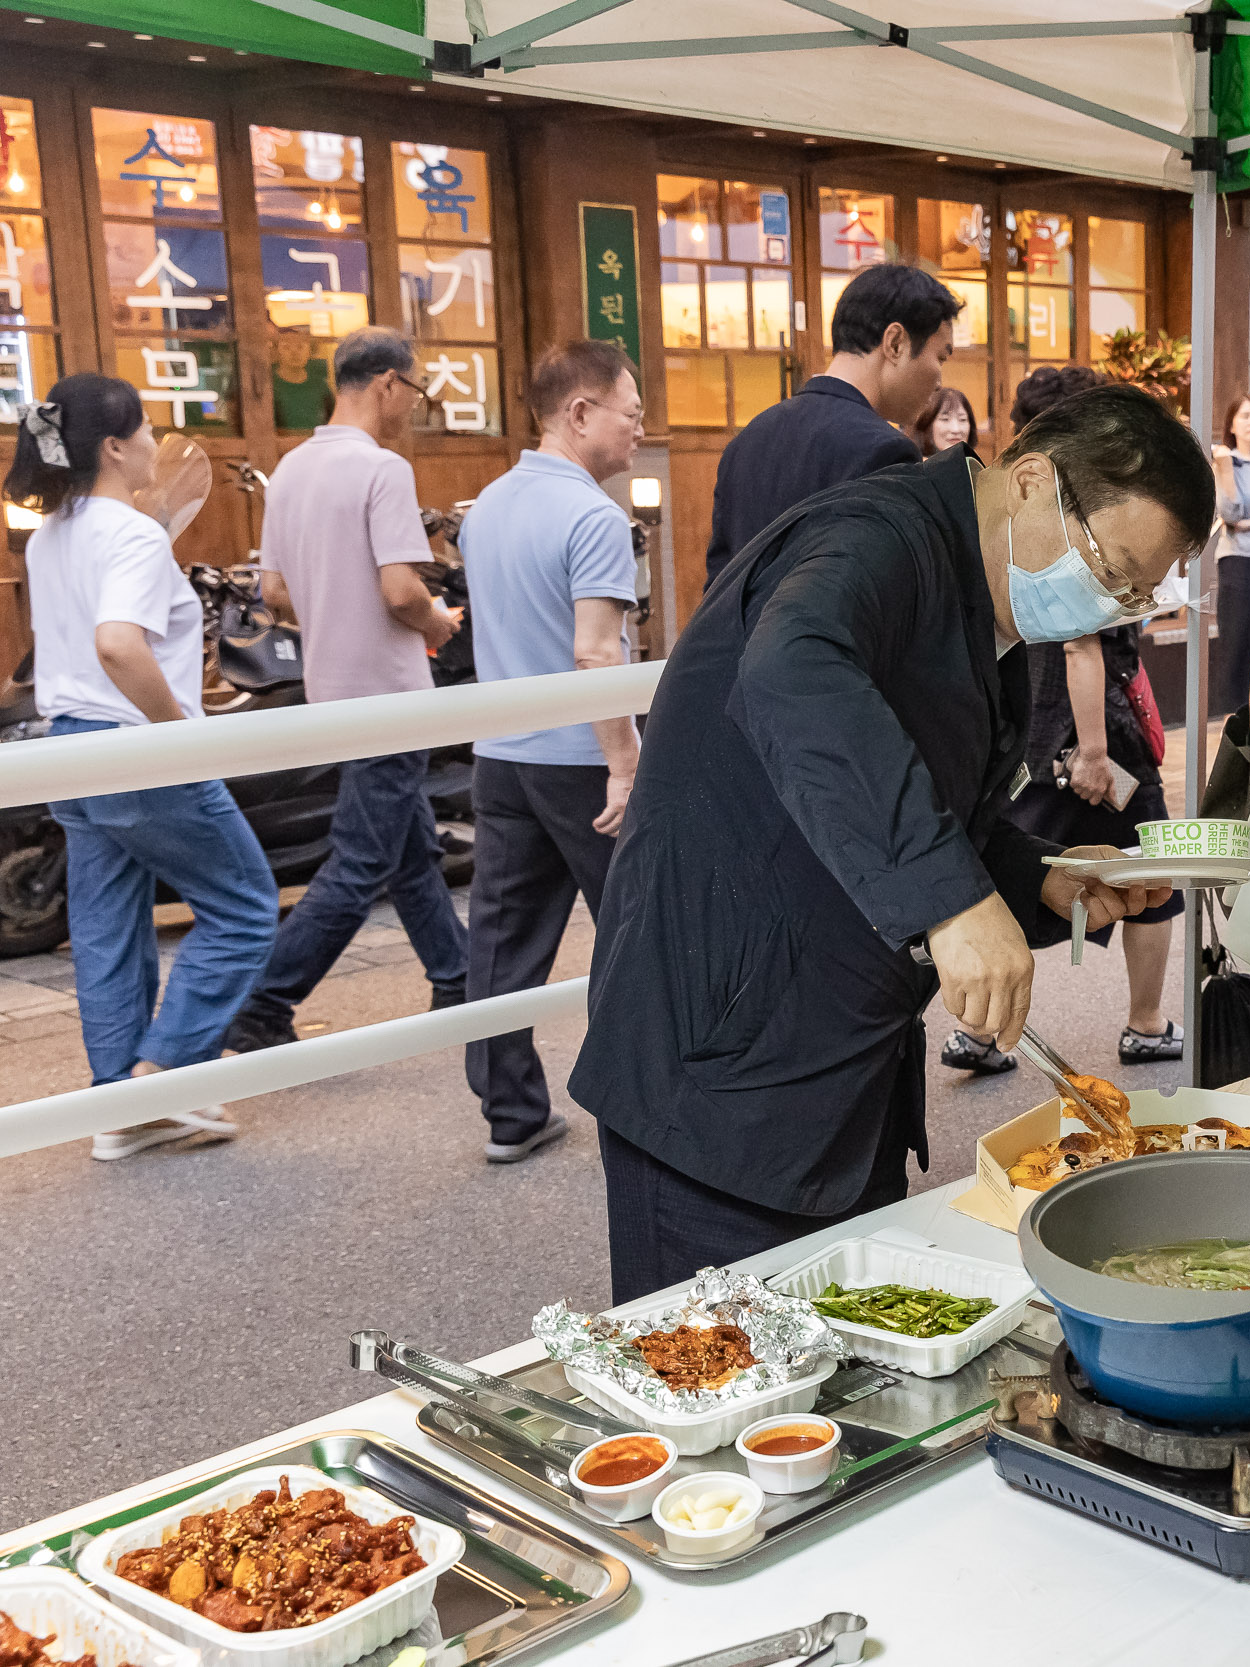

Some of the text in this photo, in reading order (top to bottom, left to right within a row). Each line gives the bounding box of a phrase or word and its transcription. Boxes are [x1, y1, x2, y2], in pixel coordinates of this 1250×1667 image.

[138, 346, 487, 430] 무 침
[1162, 823, 1202, 841] ECO
[1208, 823, 1218, 856] GREEN
[1219, 823, 1229, 856] HELLO
[1142, 836, 1159, 847] GREEN
[1231, 838, 1242, 847] THE
[1164, 843, 1203, 856] PAPER
[1230, 848, 1236, 857] A
